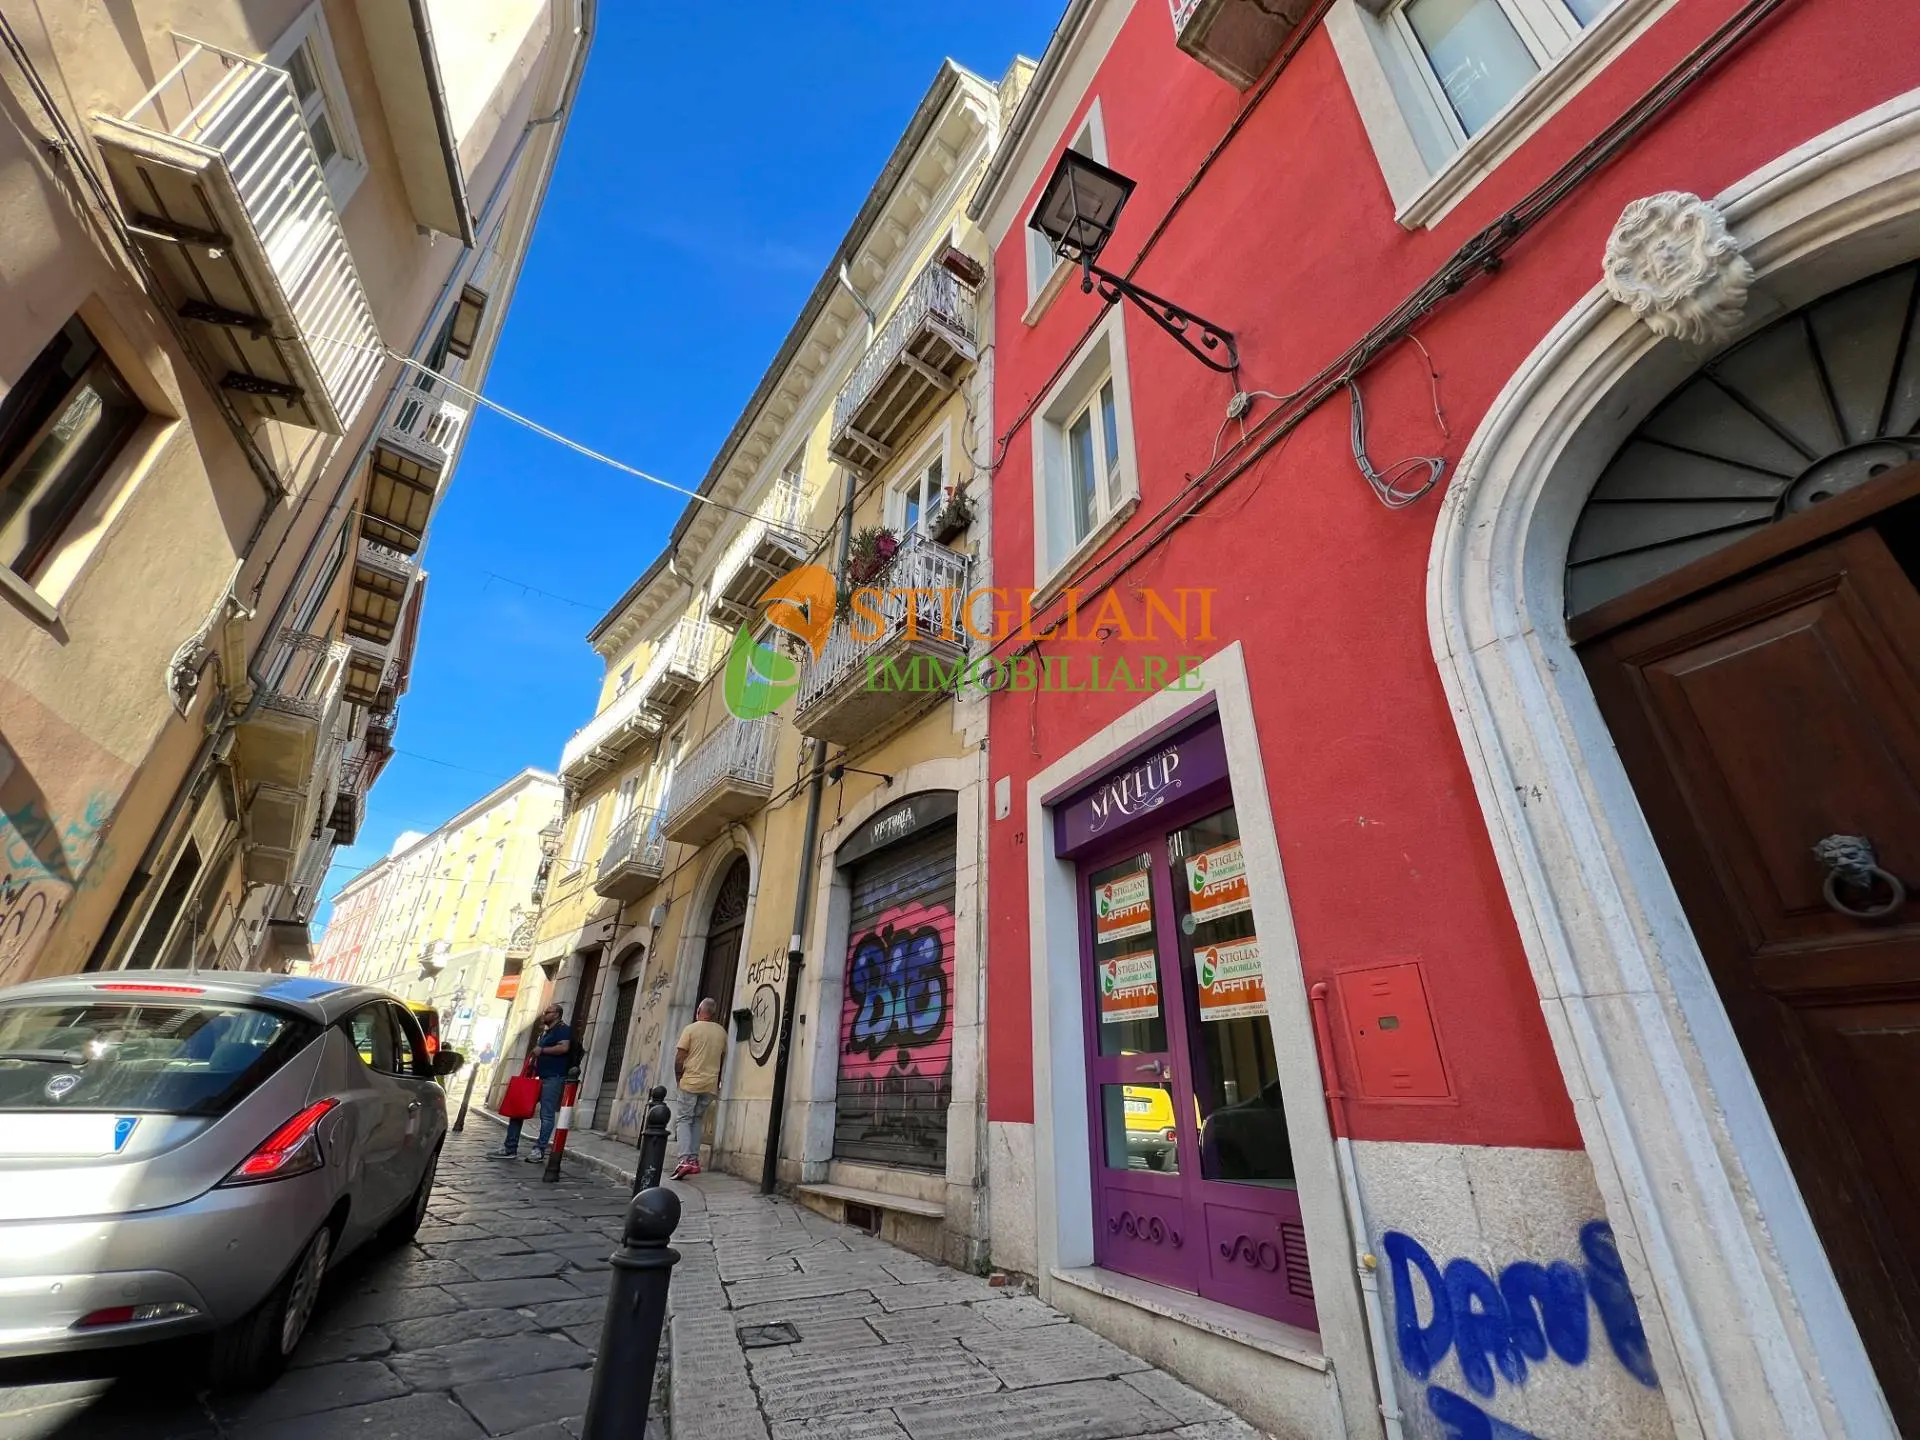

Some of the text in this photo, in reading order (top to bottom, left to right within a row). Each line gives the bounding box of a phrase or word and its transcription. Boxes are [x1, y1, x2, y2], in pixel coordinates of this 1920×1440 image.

[1208, 851, 1245, 869] STIGLIA
[1211, 862, 1246, 878] IMMOBILIA
[1203, 876, 1248, 899] AFFITT
[1107, 901, 1151, 922] AFFITTA
[1219, 947, 1261, 964] STIGLIAN
[1222, 961, 1262, 976] IMMOBILIAR
[1111, 984, 1157, 1001] AFFITTA
